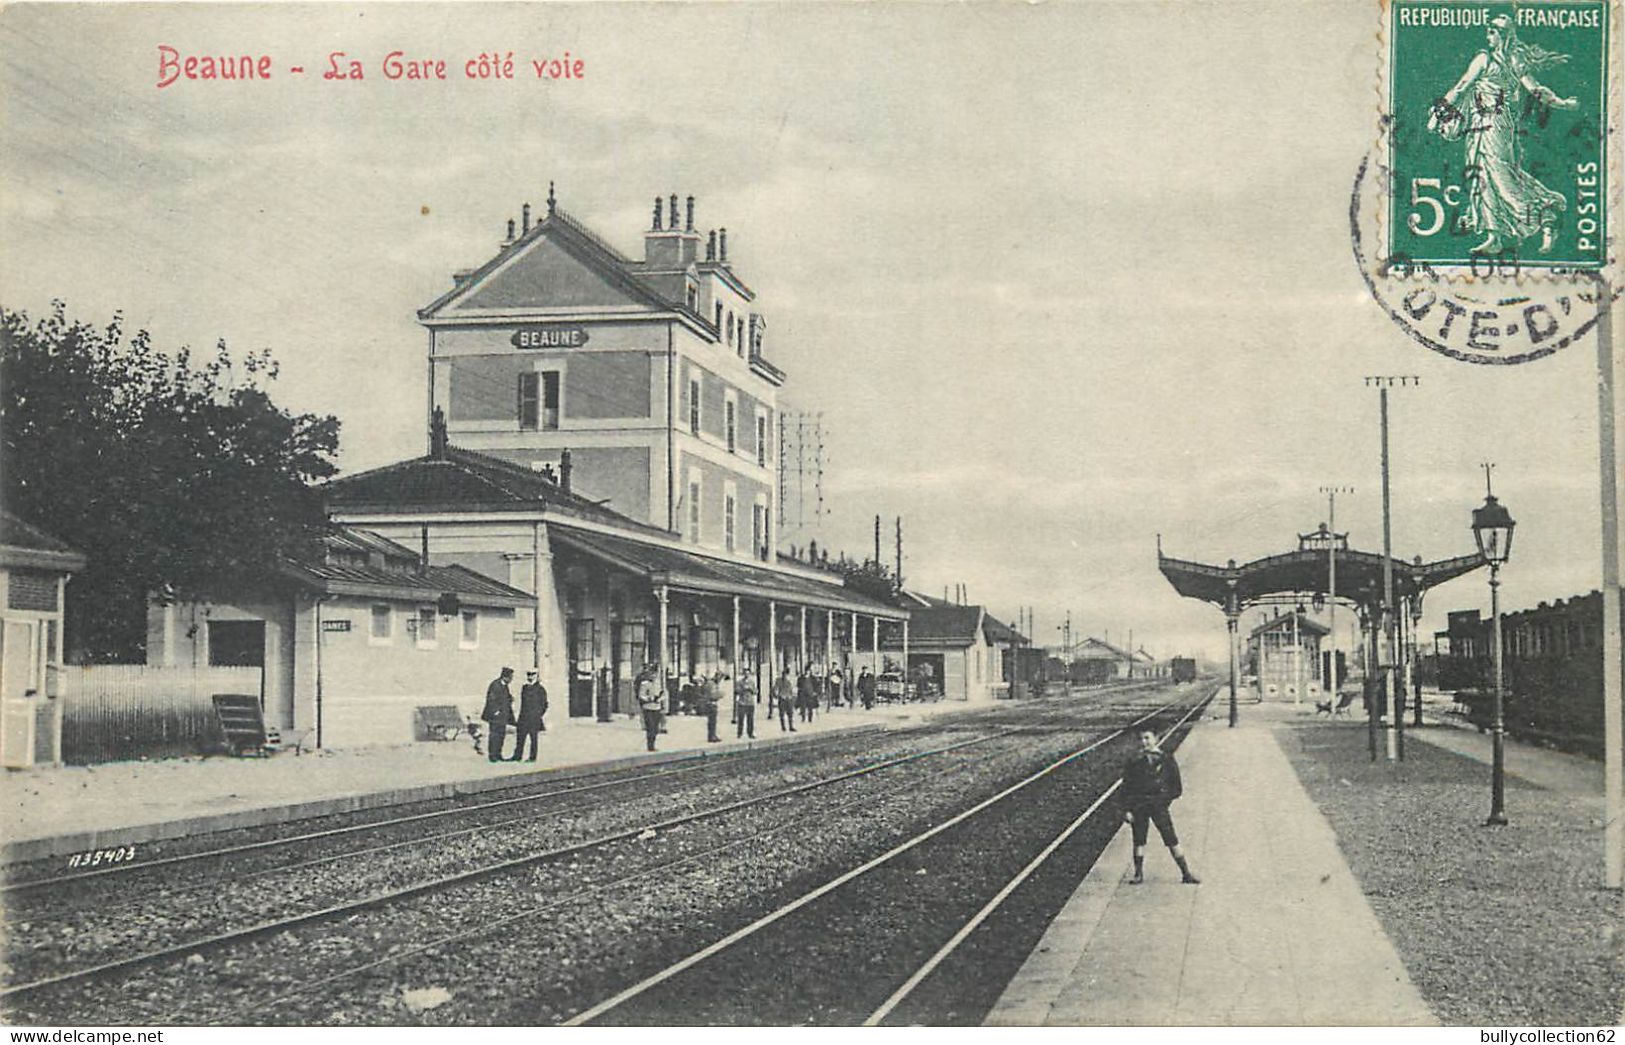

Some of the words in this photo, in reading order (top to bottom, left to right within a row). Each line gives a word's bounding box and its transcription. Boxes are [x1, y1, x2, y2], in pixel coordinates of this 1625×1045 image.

[1400, 8, 1490, 29] REPUBLIQUE
[1517, 8, 1600, 29] FRANÇAISE
[1576, 160, 1598, 251] POSTES
[520, 331, 580, 346] BEAUNE
